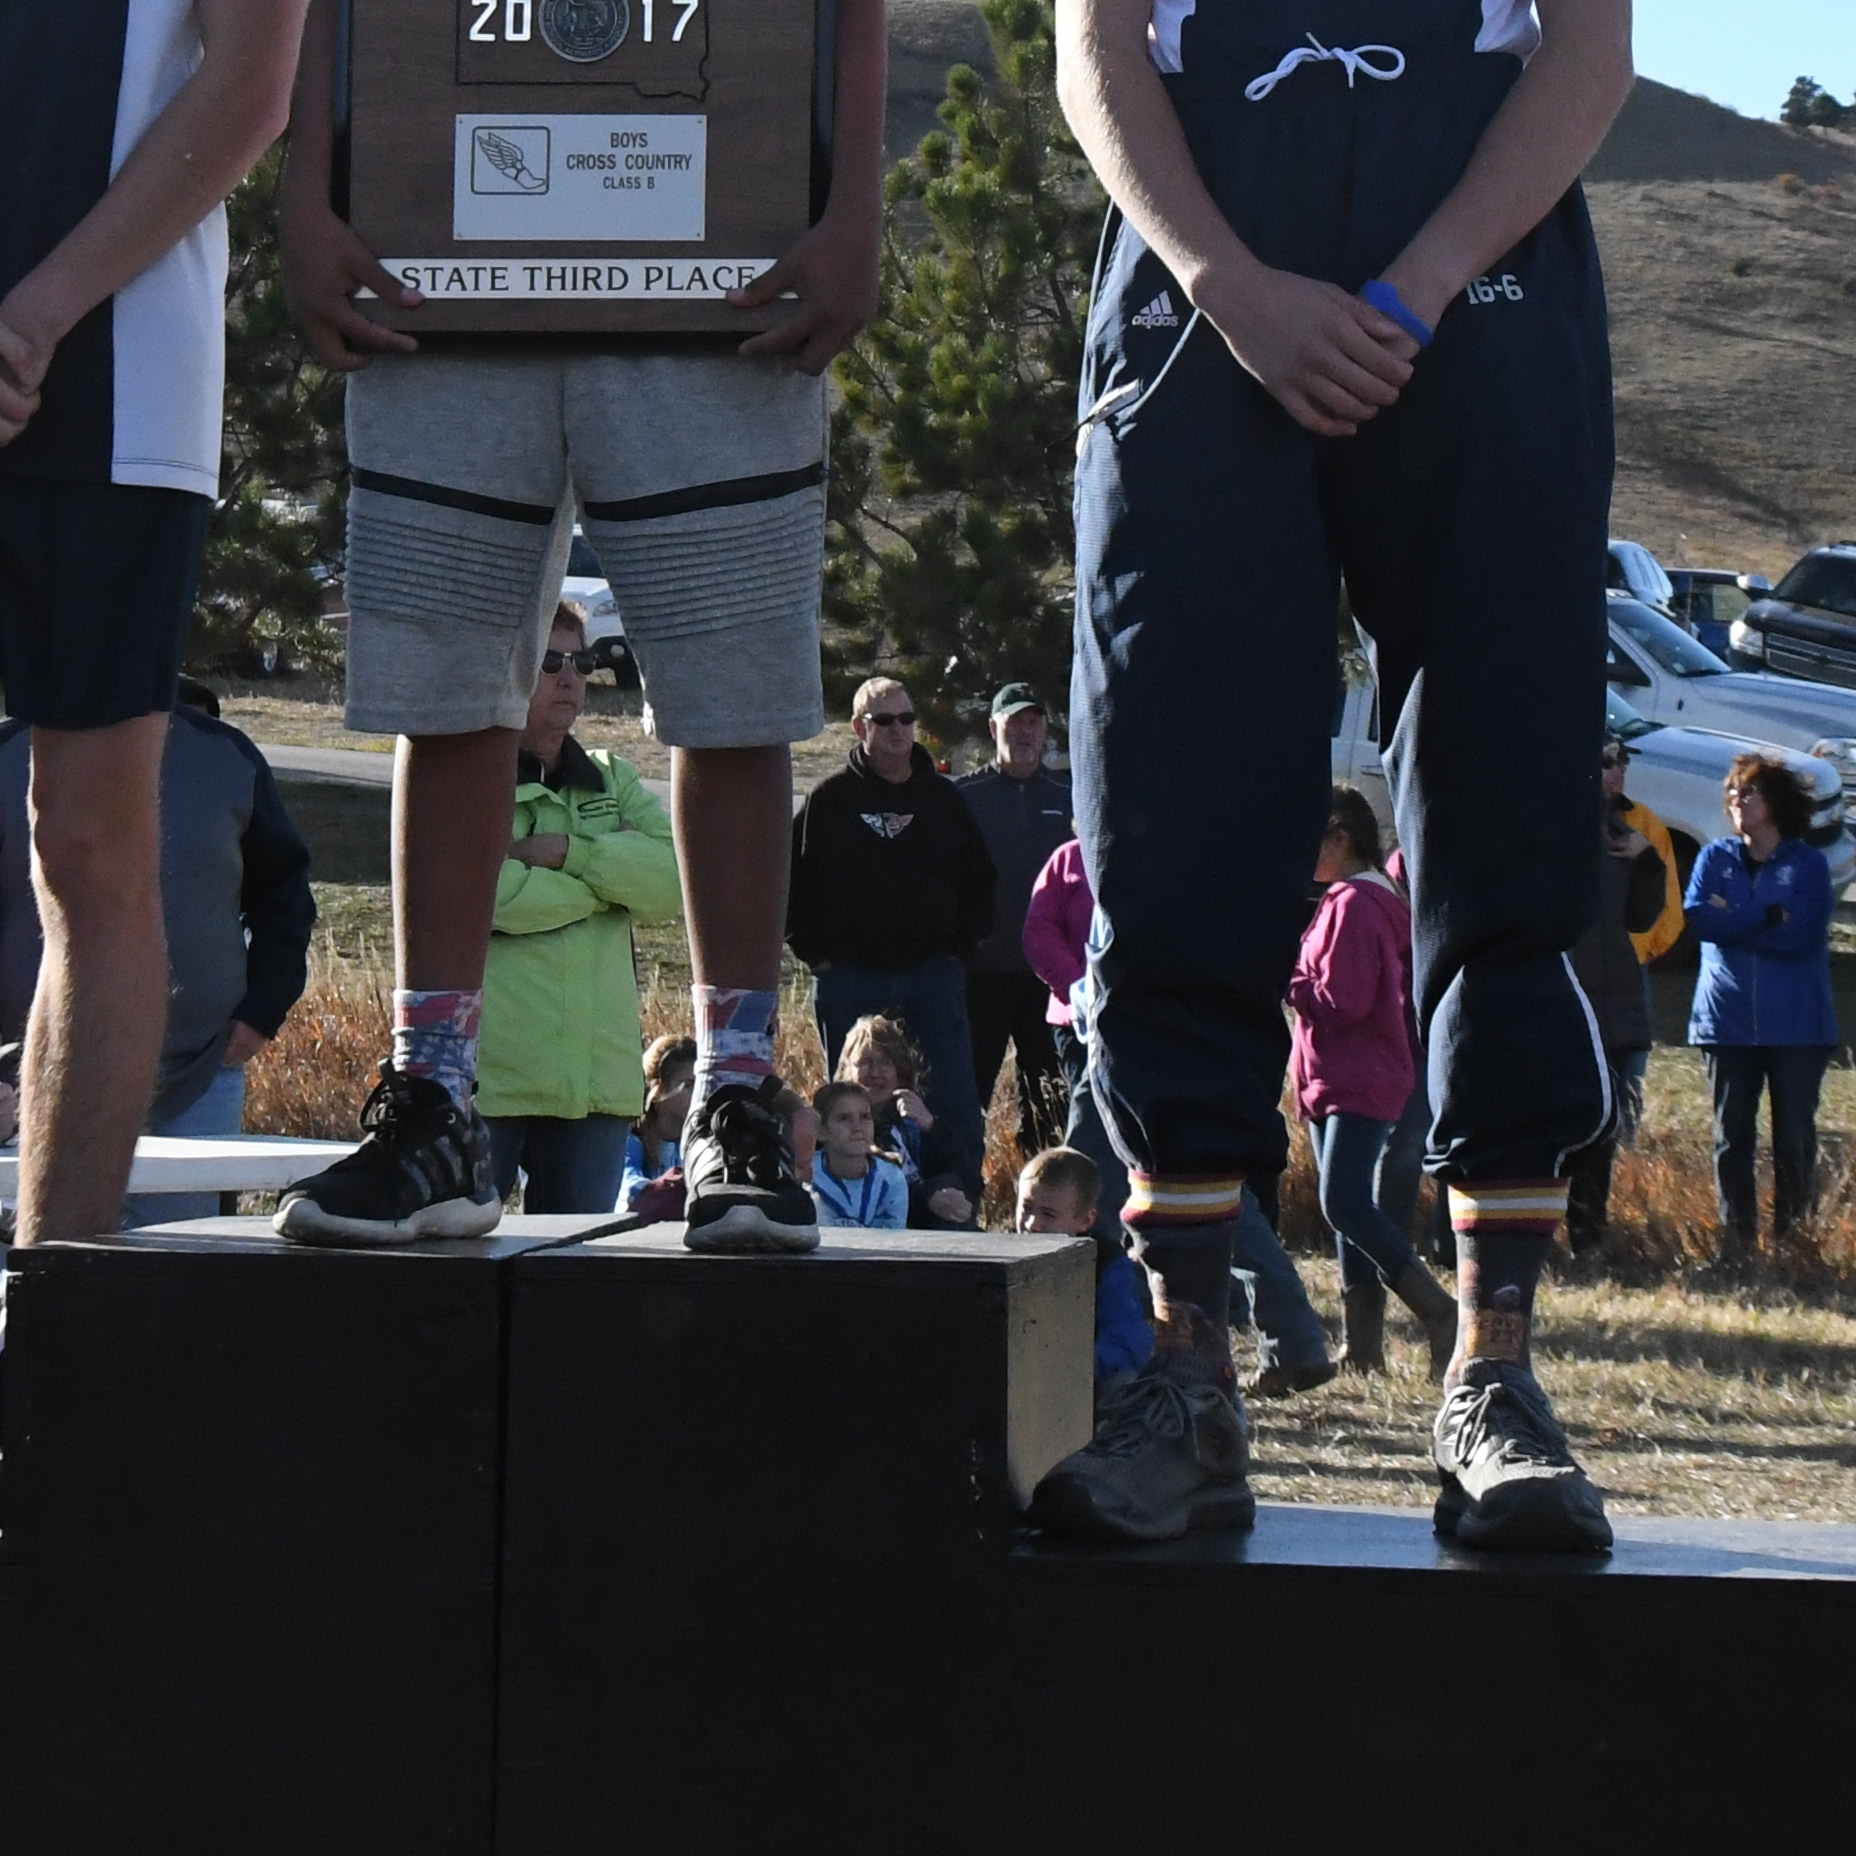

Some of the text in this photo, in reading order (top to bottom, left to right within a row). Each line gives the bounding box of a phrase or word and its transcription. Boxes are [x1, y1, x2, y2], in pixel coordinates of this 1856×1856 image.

[610, 132, 648, 148] BOYS
[566, 153, 693, 170] CROSS COUNTRY
[603, 176, 655, 190] CLASS B
[400, 265, 510, 291] STATE
[523, 265, 629, 291] THIRD
[1466, 274, 1524, 304] 16-6
[1131, 314, 1178, 329] adidas
